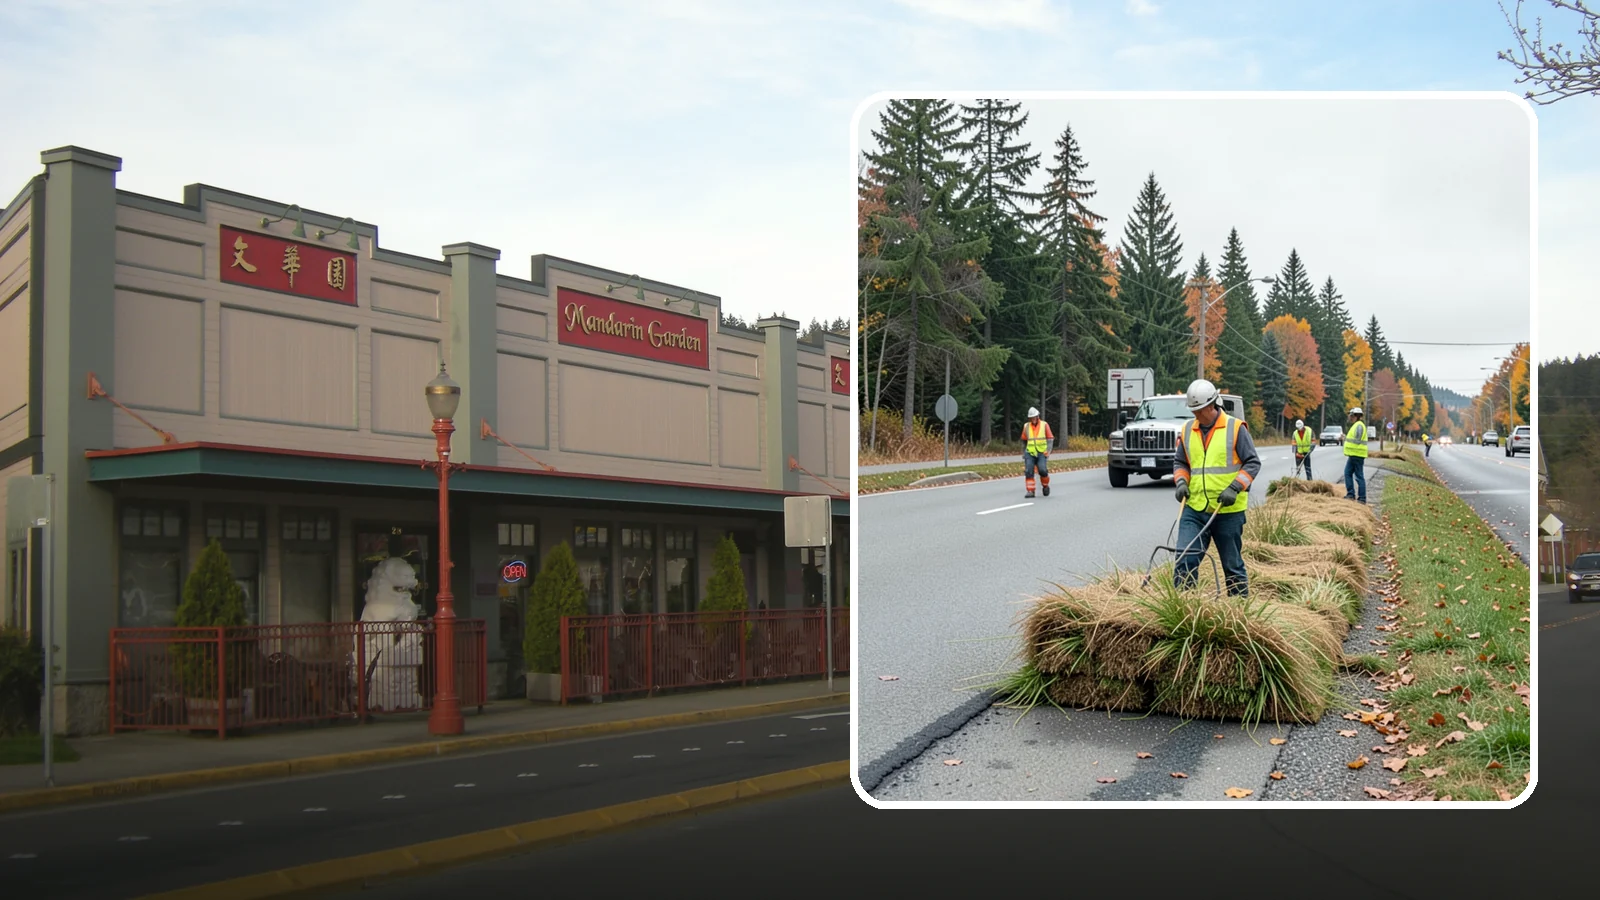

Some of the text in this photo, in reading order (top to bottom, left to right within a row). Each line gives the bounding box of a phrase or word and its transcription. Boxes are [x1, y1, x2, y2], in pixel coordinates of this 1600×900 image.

[230, 235, 346, 291] 文華園
[564, 302, 702, 352] Mandarin Garden
[503, 565, 527, 578] OPEN
